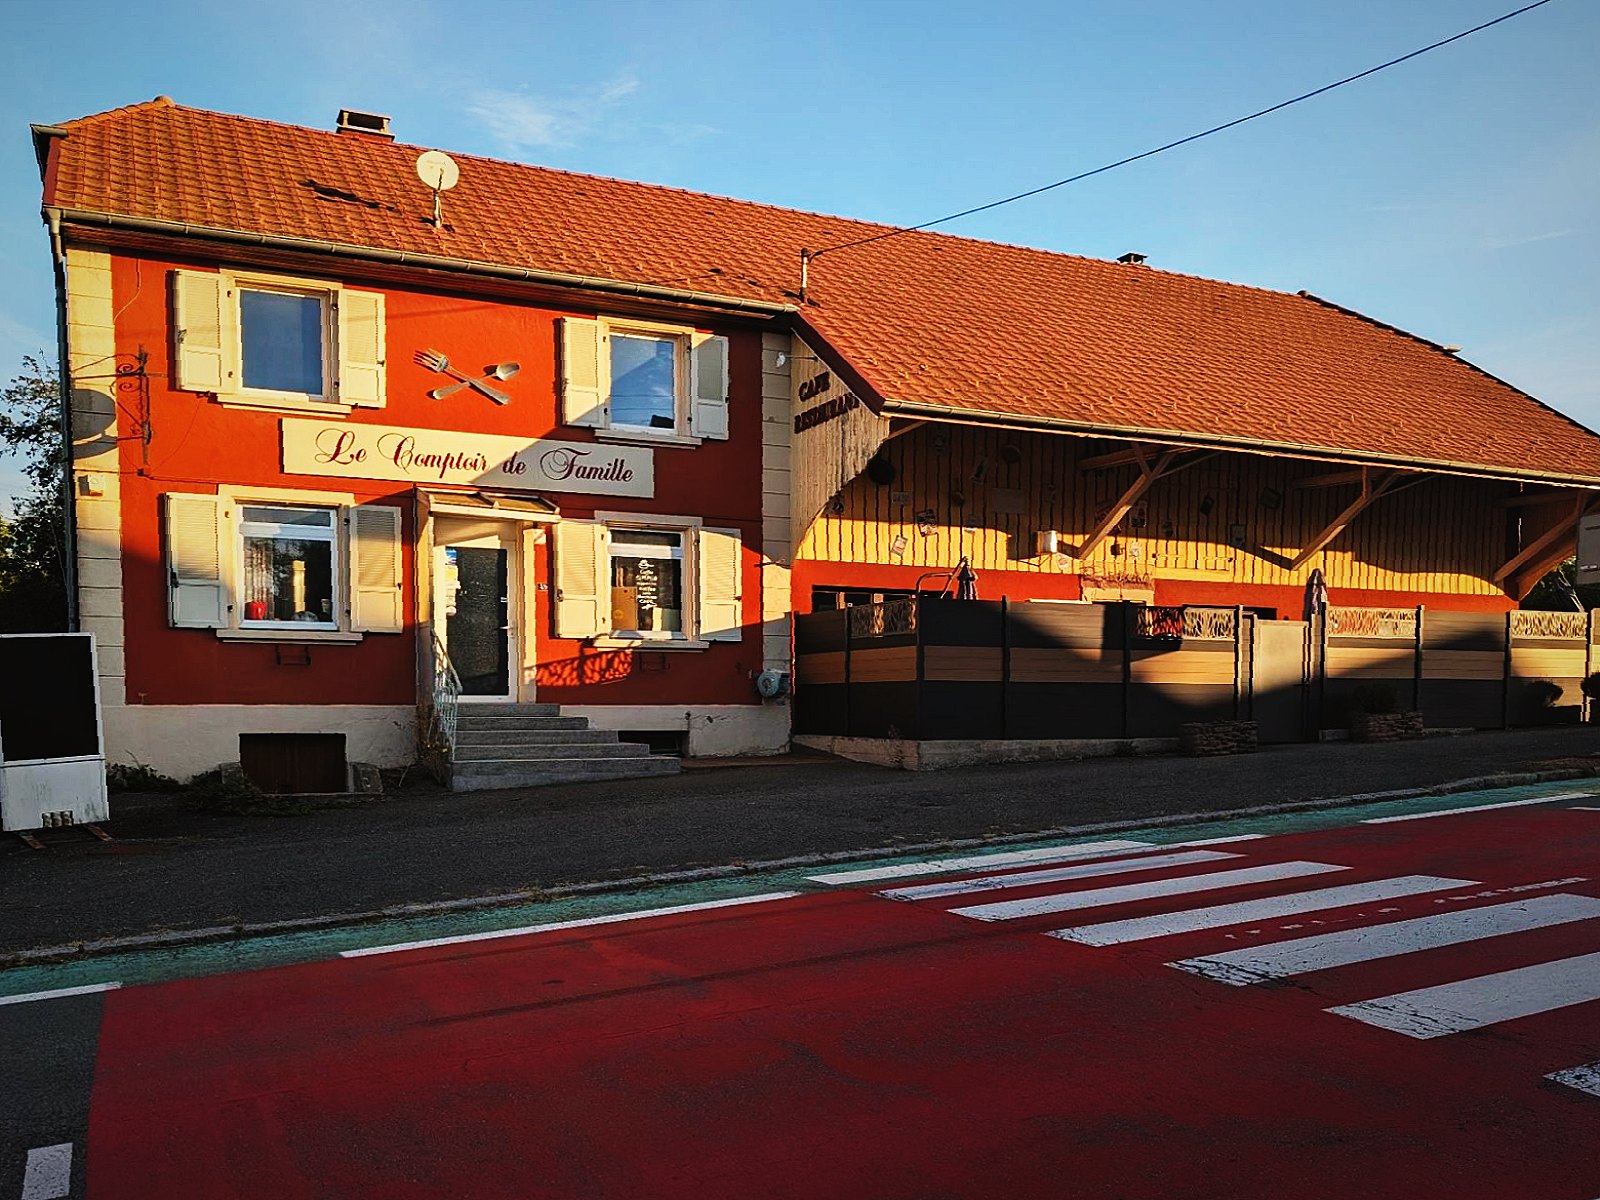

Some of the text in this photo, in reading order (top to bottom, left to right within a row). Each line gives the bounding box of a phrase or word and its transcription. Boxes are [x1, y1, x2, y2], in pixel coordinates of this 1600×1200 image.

[315, 427, 633, 482] Le Comptoir de Famille
